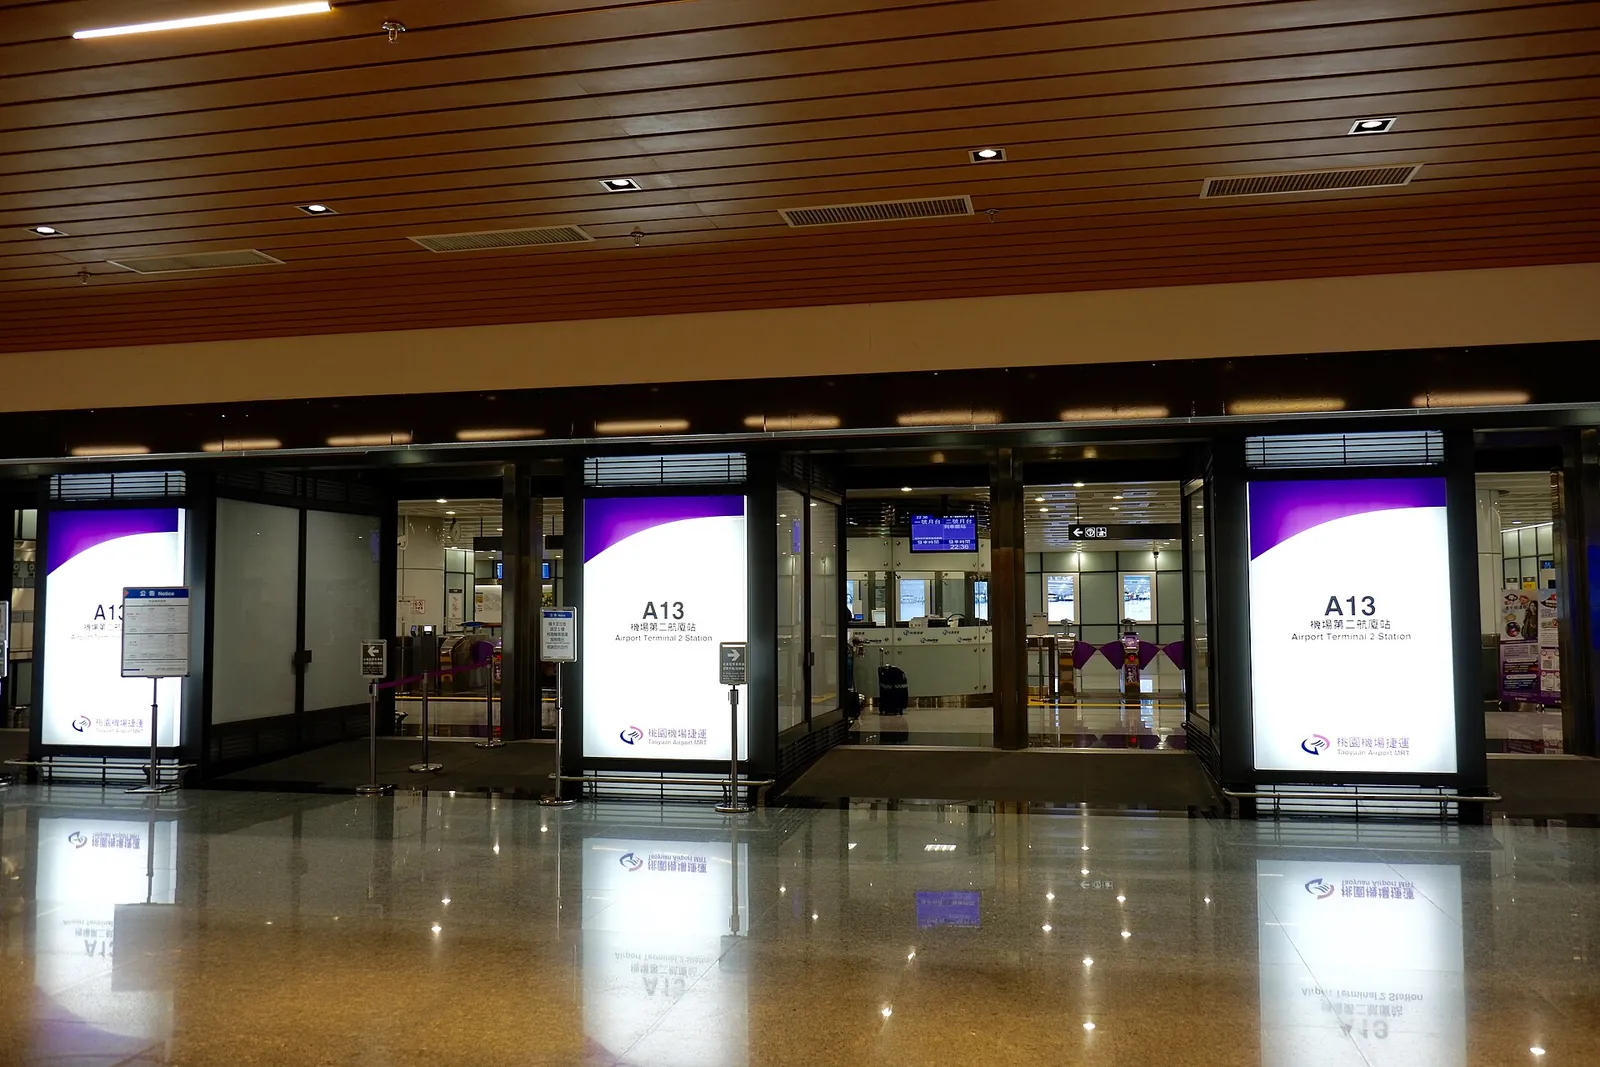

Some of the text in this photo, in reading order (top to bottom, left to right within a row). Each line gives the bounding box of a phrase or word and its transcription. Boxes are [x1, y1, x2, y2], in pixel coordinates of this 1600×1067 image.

[642, 601, 685, 620] A13
[1324, 595, 1376, 616] A13
[615, 634, 641, 643] Airport
[643, 634, 677, 642] Terminal
[685, 634, 713, 642] Station
[1291, 632, 1412, 642] Airport Terminal 2 Station
[648, 727, 707, 739] 桃園機場捷運
[1337, 737, 1410, 749] 桃園機場捷運
[1337, 749, 1366, 757] Taoyuan
[1368, 749, 1393, 757] Airport
